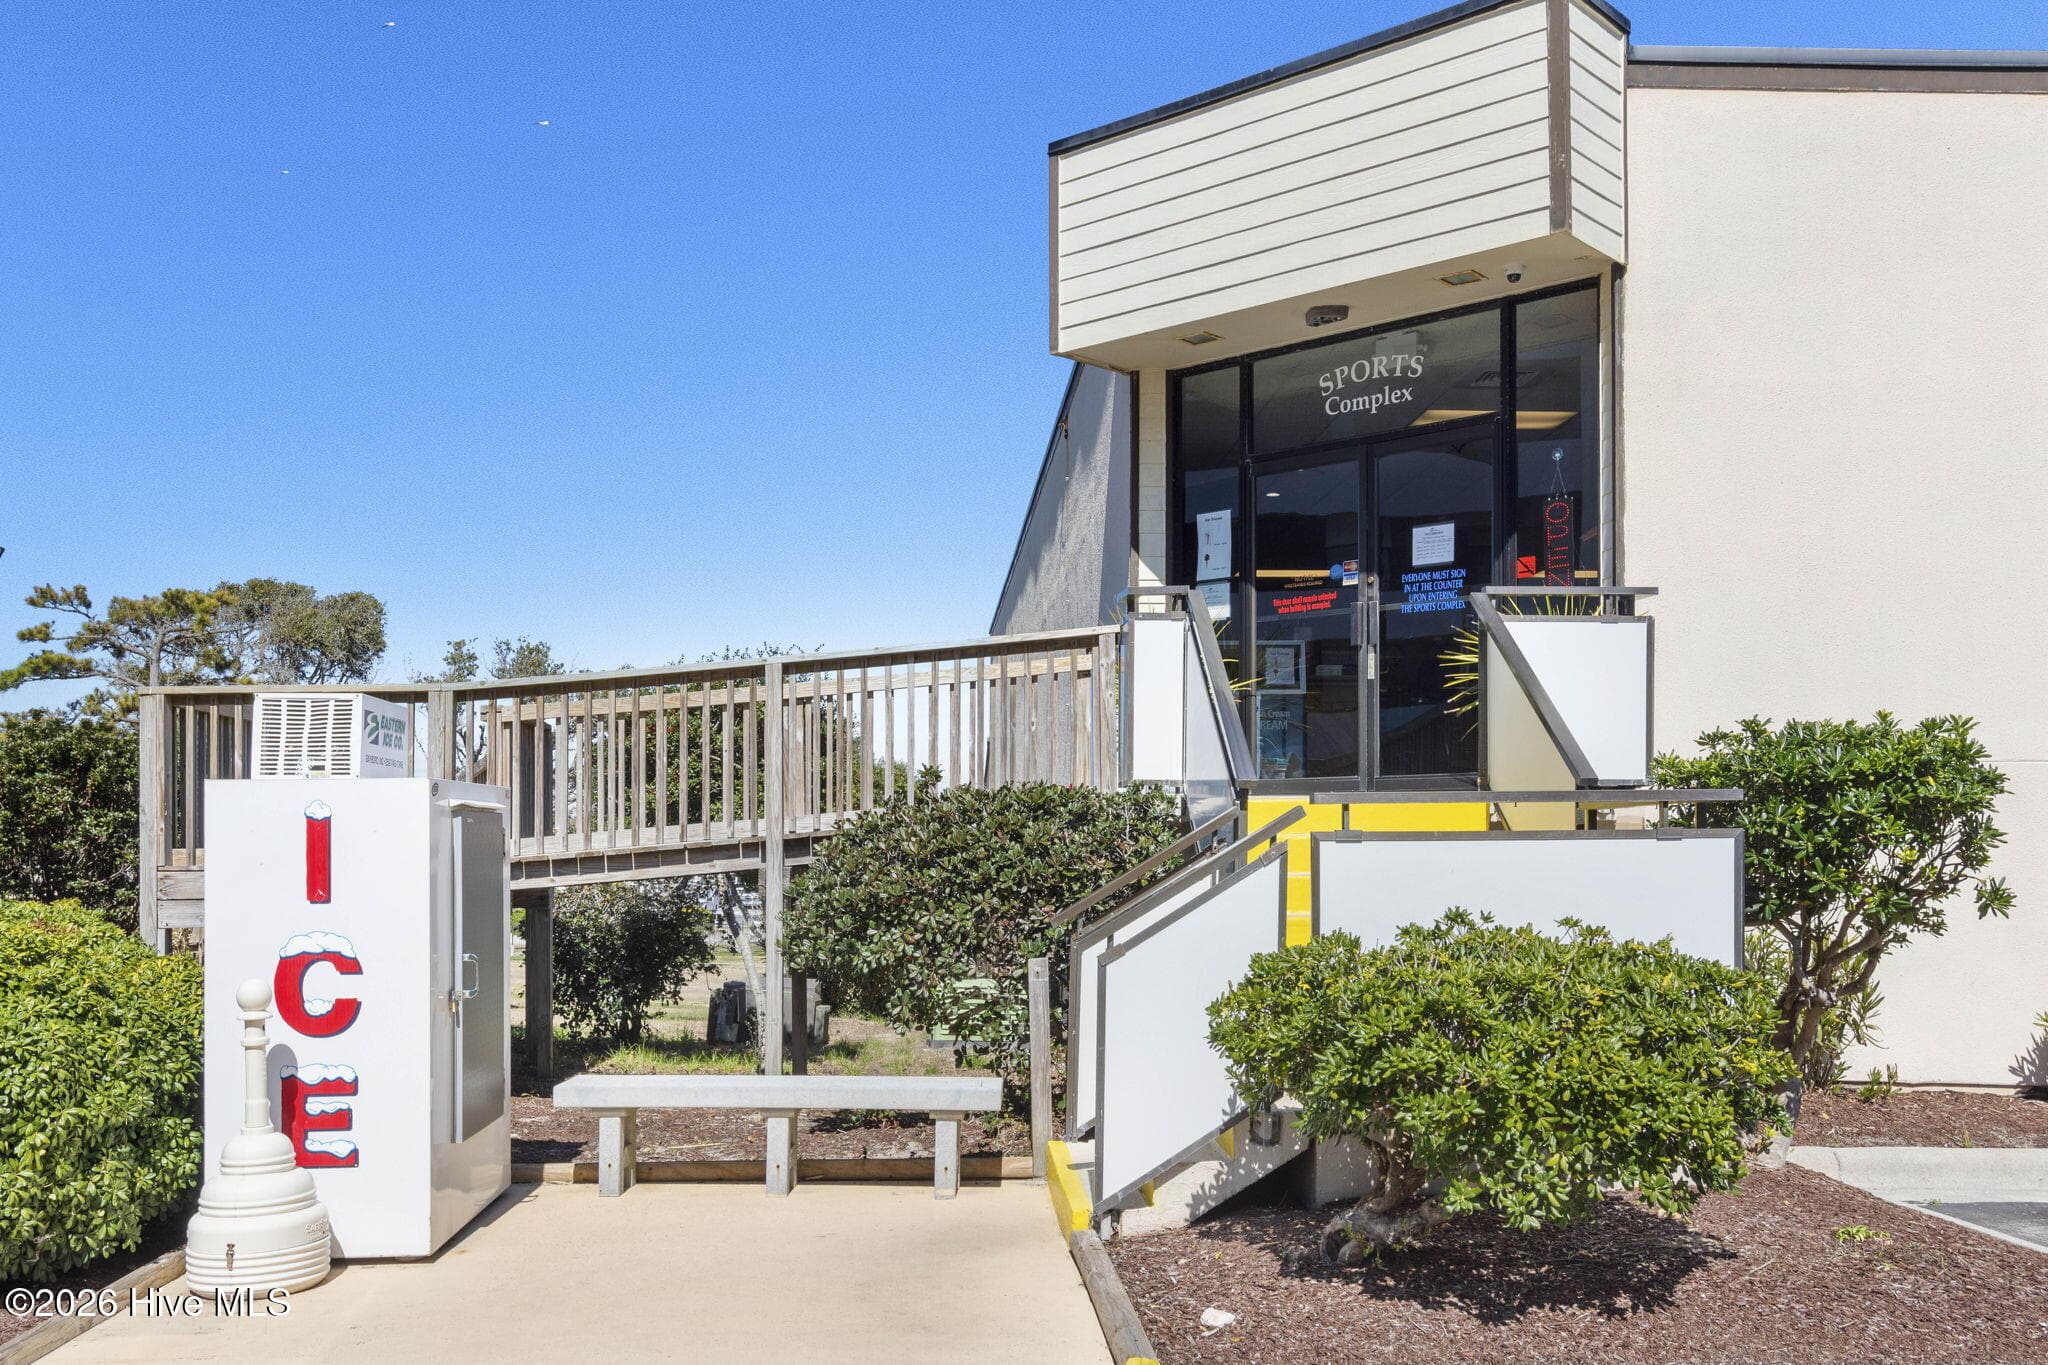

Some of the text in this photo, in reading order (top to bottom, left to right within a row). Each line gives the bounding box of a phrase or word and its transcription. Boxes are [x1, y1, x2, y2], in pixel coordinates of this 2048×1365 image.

[1319, 354, 1424, 396] SPORTS
[1325, 385, 1413, 415] Complex
[1545, 502, 1570, 587] OPEN
[1402, 568, 1466, 582] EVERYONE MUST SIGN
[1404, 579, 1464, 593] IN AT THE COUNTER
[1408, 589, 1458, 603] UPON ENTERING
[1401, 600, 1466, 614] THE SPORTS COMPLEX
[380, 715, 406, 735] EASTERN
[383, 732, 404, 750] ICE CO.
[274, 800, 363, 1169] ICE
